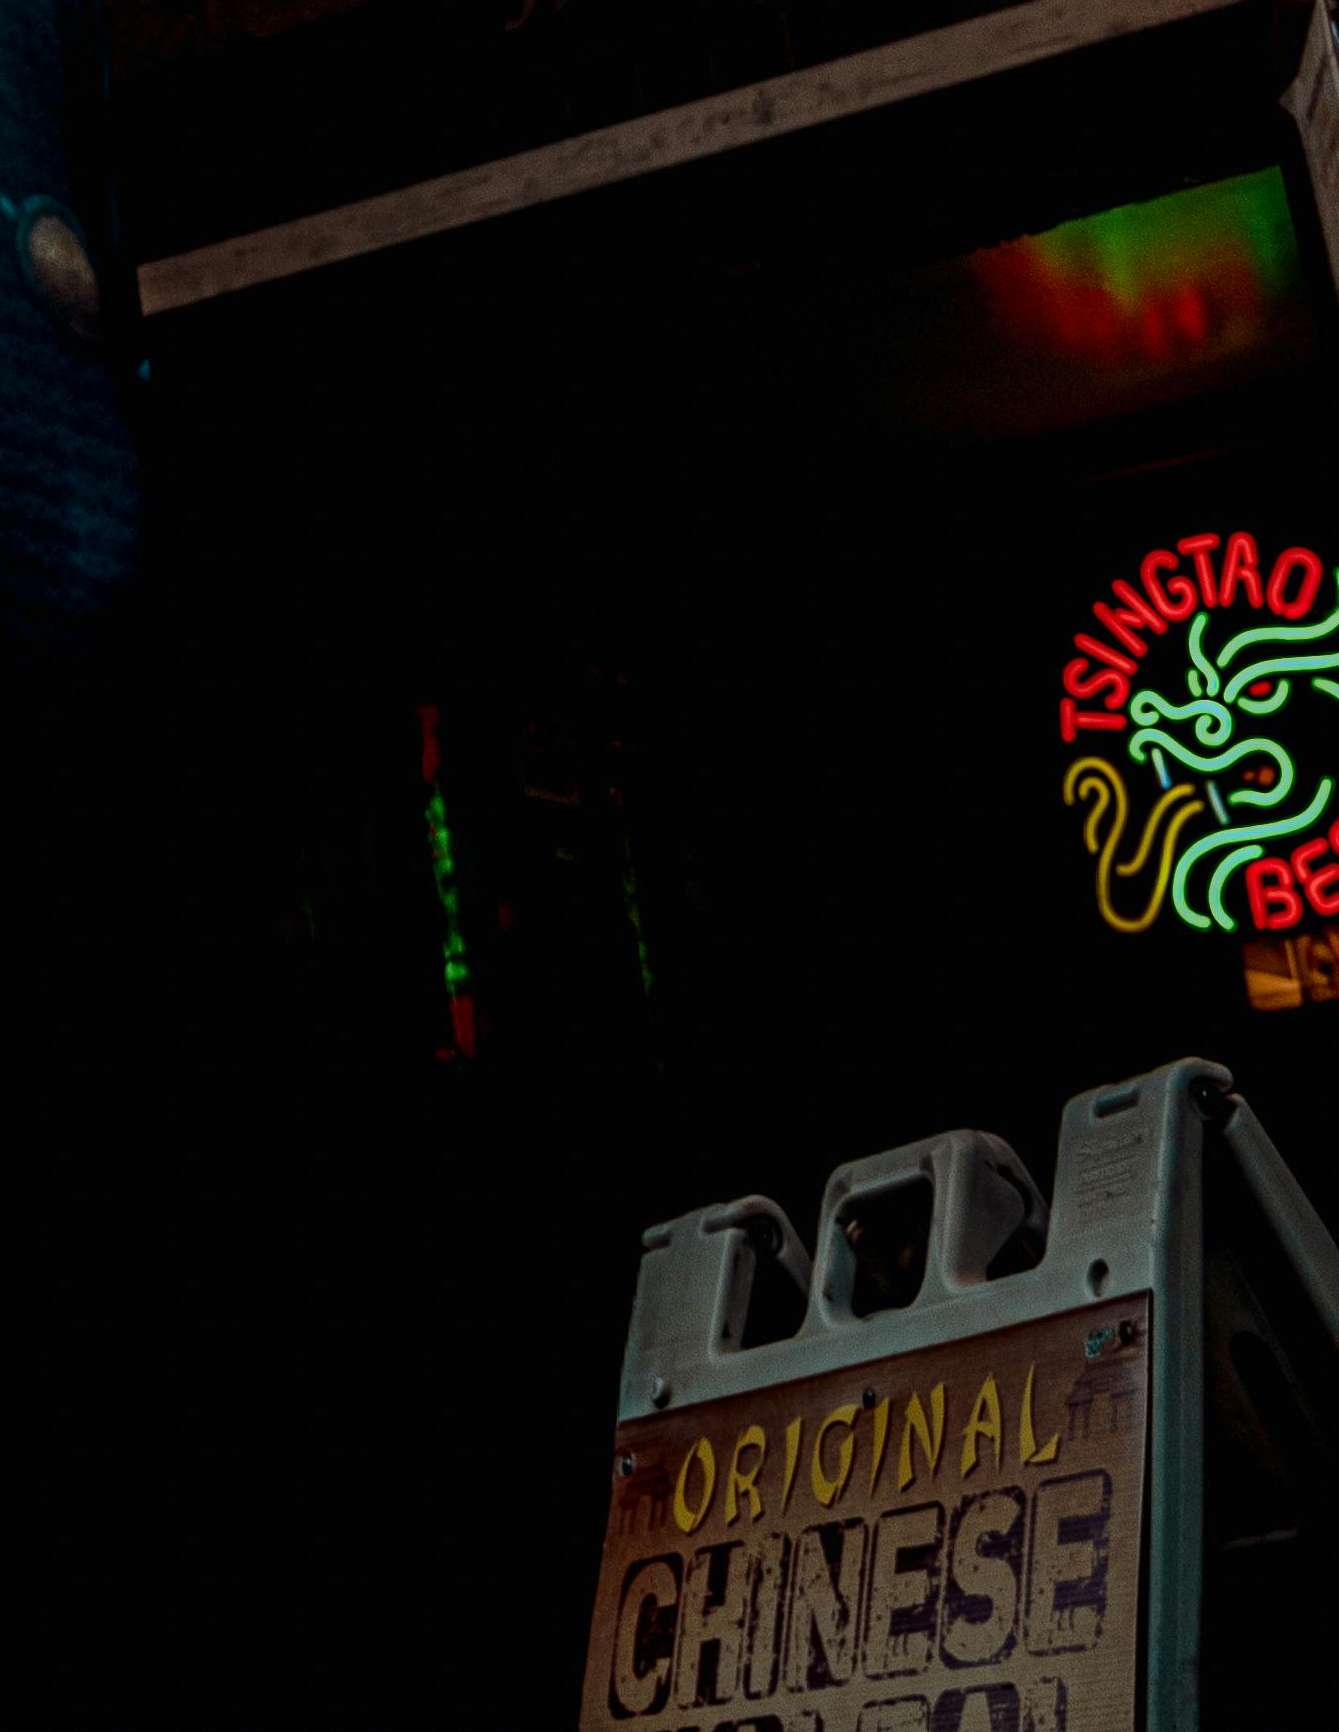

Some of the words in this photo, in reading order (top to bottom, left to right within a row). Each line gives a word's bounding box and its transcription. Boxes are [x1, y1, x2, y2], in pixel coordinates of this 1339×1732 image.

[1059, 531, 1323, 743] TSINGTAO
[1244, 817, 1339, 931] BE
[672, 1362, 1063, 1534] ORIGINAL
[608, 1469, 1113, 1719] CHINESE
